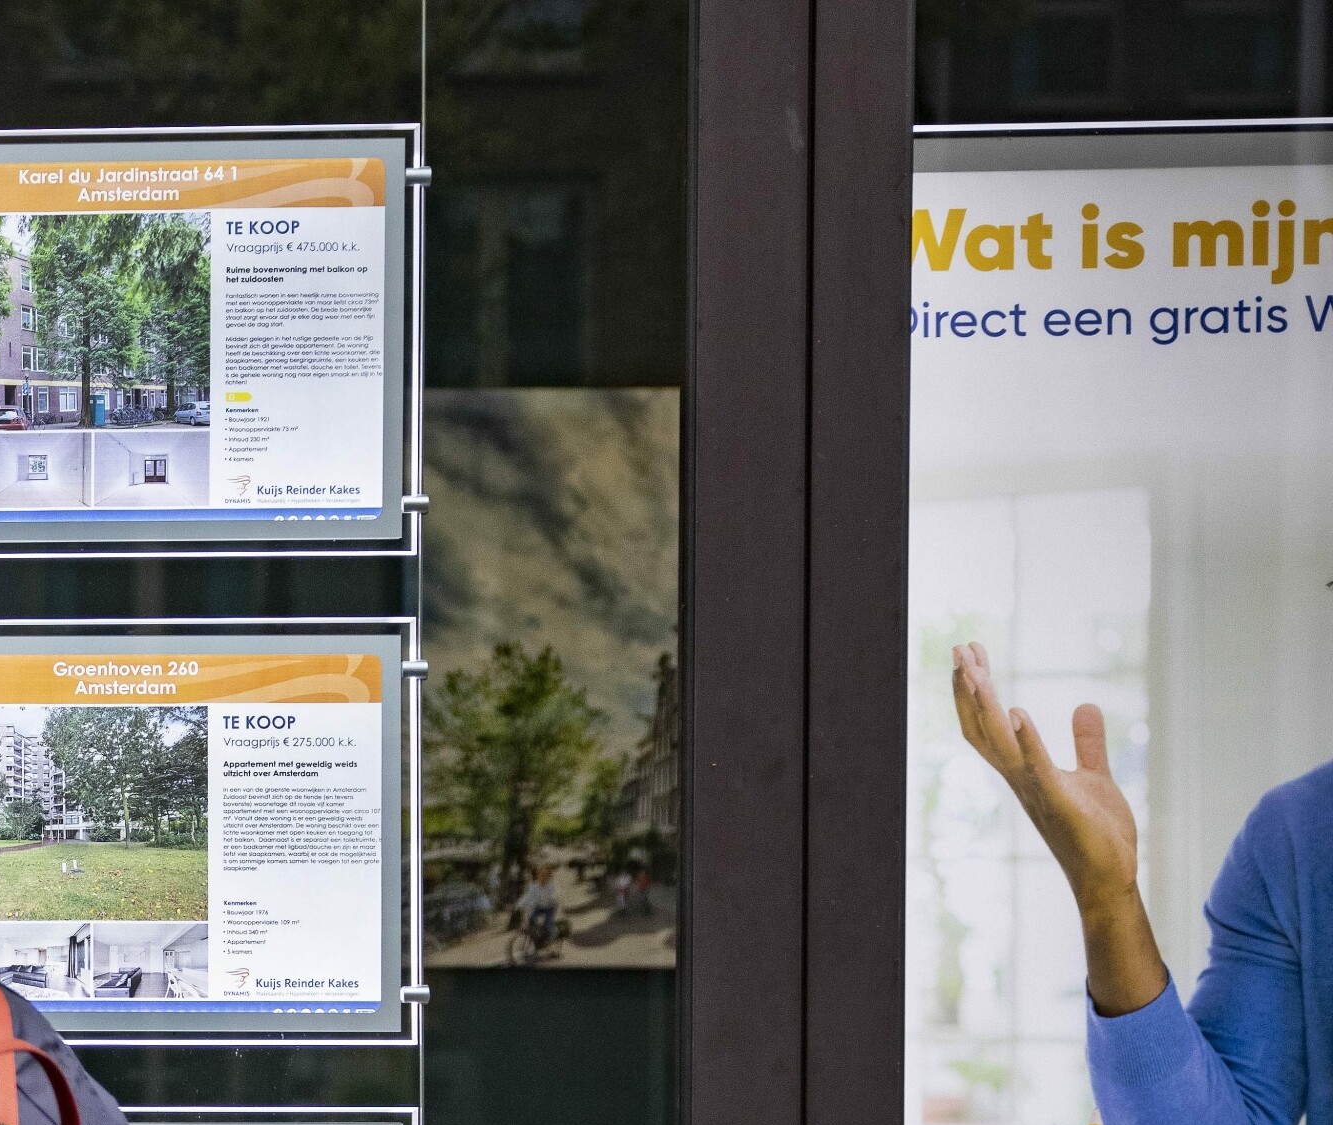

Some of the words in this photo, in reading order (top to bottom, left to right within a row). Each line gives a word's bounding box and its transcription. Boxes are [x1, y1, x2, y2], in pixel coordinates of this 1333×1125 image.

[19, 169, 63, 184] Karel
[69, 169, 90, 184] du
[97, 167, 199, 184] Jardinstraat
[203, 166, 226, 181] 64
[231, 166, 237, 180] 1
[78, 186, 179, 202] Amsterdam
[226, 222, 242, 235] TE
[250, 220, 300, 234] KOOP
[227, 242, 283, 254] Vraagprijs
[287, 242, 293, 252] €
[297, 242, 338, 251] 475.000
[342, 242, 360, 251] k.k.
[912, 208, 1053, 272] Wat
[1081, 203, 1145, 270] is
[1172, 200, 1333, 284] mijn
[253, 266, 307, 274] bovenwoning
[1044, 307, 1131, 336] een
[1150, 296, 1288, 345] gratis
[258, 486, 282, 497] Kuijs
[287, 485, 326, 494] Reinder
[330, 485, 360, 494] Kakes
[53, 662, 162, 677] Groenhoven
[168, 661, 198, 676] 260
[75, 680, 176, 694] Amsterdam
[223, 716, 239, 729] TE
[246, 716, 295, 729] KOOP
[224, 737, 279, 749] Vraagprijs
[283, 737, 289, 746] €
[293, 737, 335, 747] 275.000
[339, 737, 356, 746] k.k.
[223, 761, 276, 769] Appartement
[296, 761, 332, 769] geweldig
[256, 979, 281, 990] Kuijs
[285, 979, 325, 988] Reinder
[329, 979, 359, 988] Kakes
